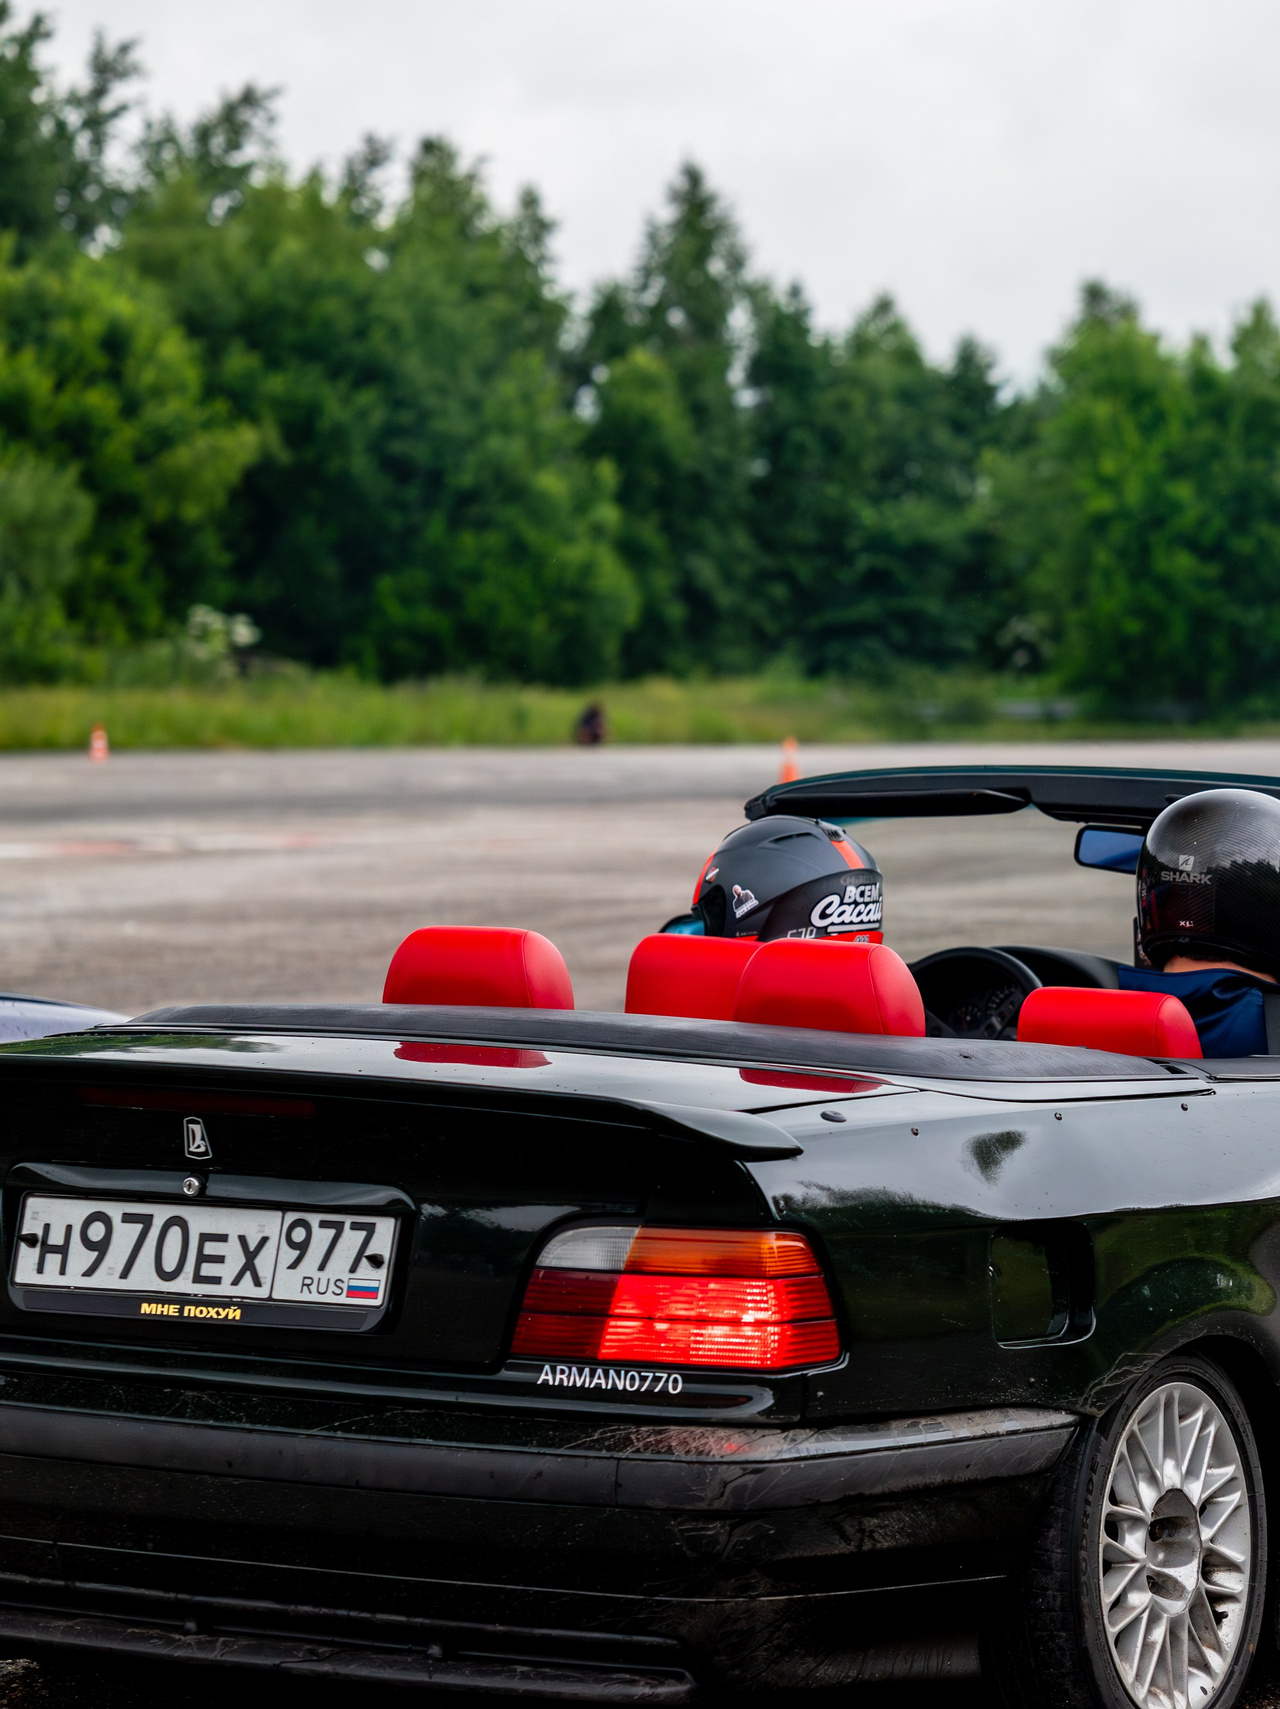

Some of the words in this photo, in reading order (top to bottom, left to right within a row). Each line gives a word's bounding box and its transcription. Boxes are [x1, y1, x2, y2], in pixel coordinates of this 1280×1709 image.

[1160, 870, 1213, 885] SHARK
[843, 882, 880, 903] ВСЕМ
[36, 1210, 270, 1288] Н970ЕХ
[284, 1218, 377, 1274] 977
[300, 1276, 345, 1296] RUS
[140, 1302, 180, 1316] МНЕ
[183, 1305, 241, 1320] ПОХУЙ
[536, 1364, 683, 1394] ARMAN0770
